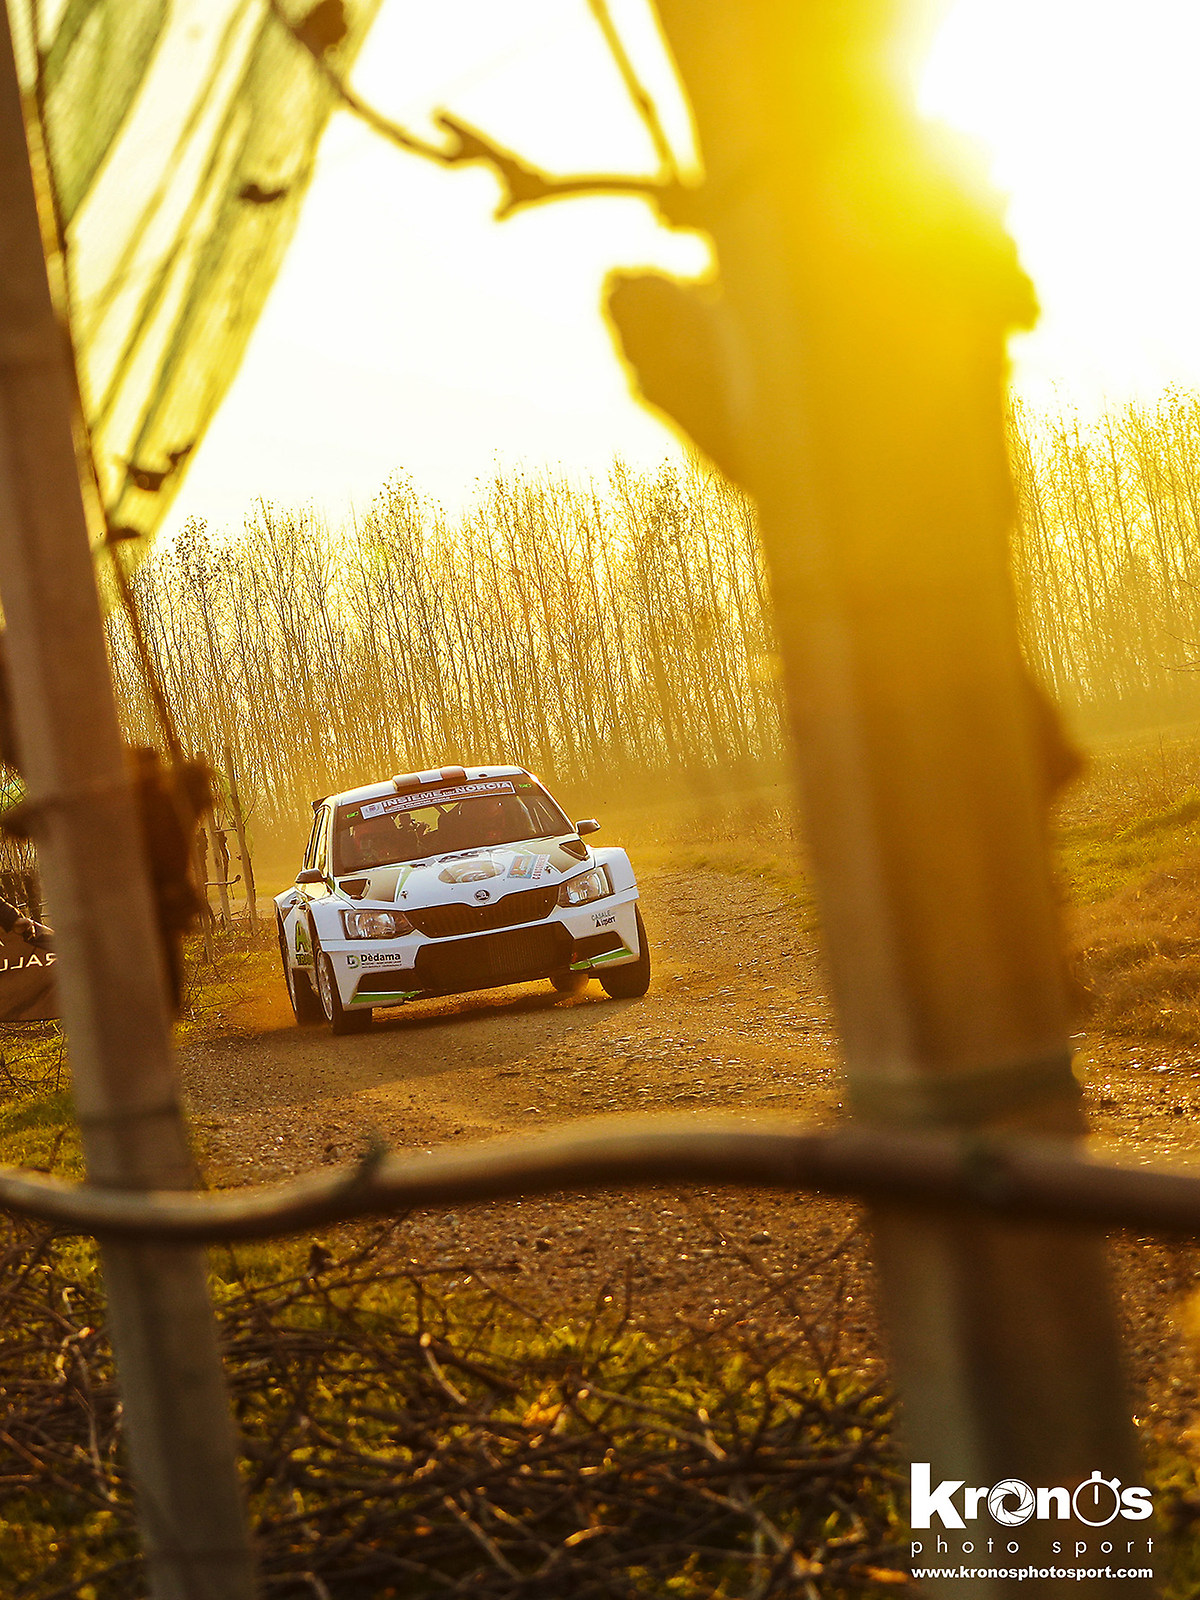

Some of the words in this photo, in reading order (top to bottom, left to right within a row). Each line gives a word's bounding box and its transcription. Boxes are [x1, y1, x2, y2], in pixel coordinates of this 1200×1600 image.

[382, 790, 442, 807] INSIEME
[455, 781, 511, 793] NORCIA
[360, 953, 401, 962] Dèdama
